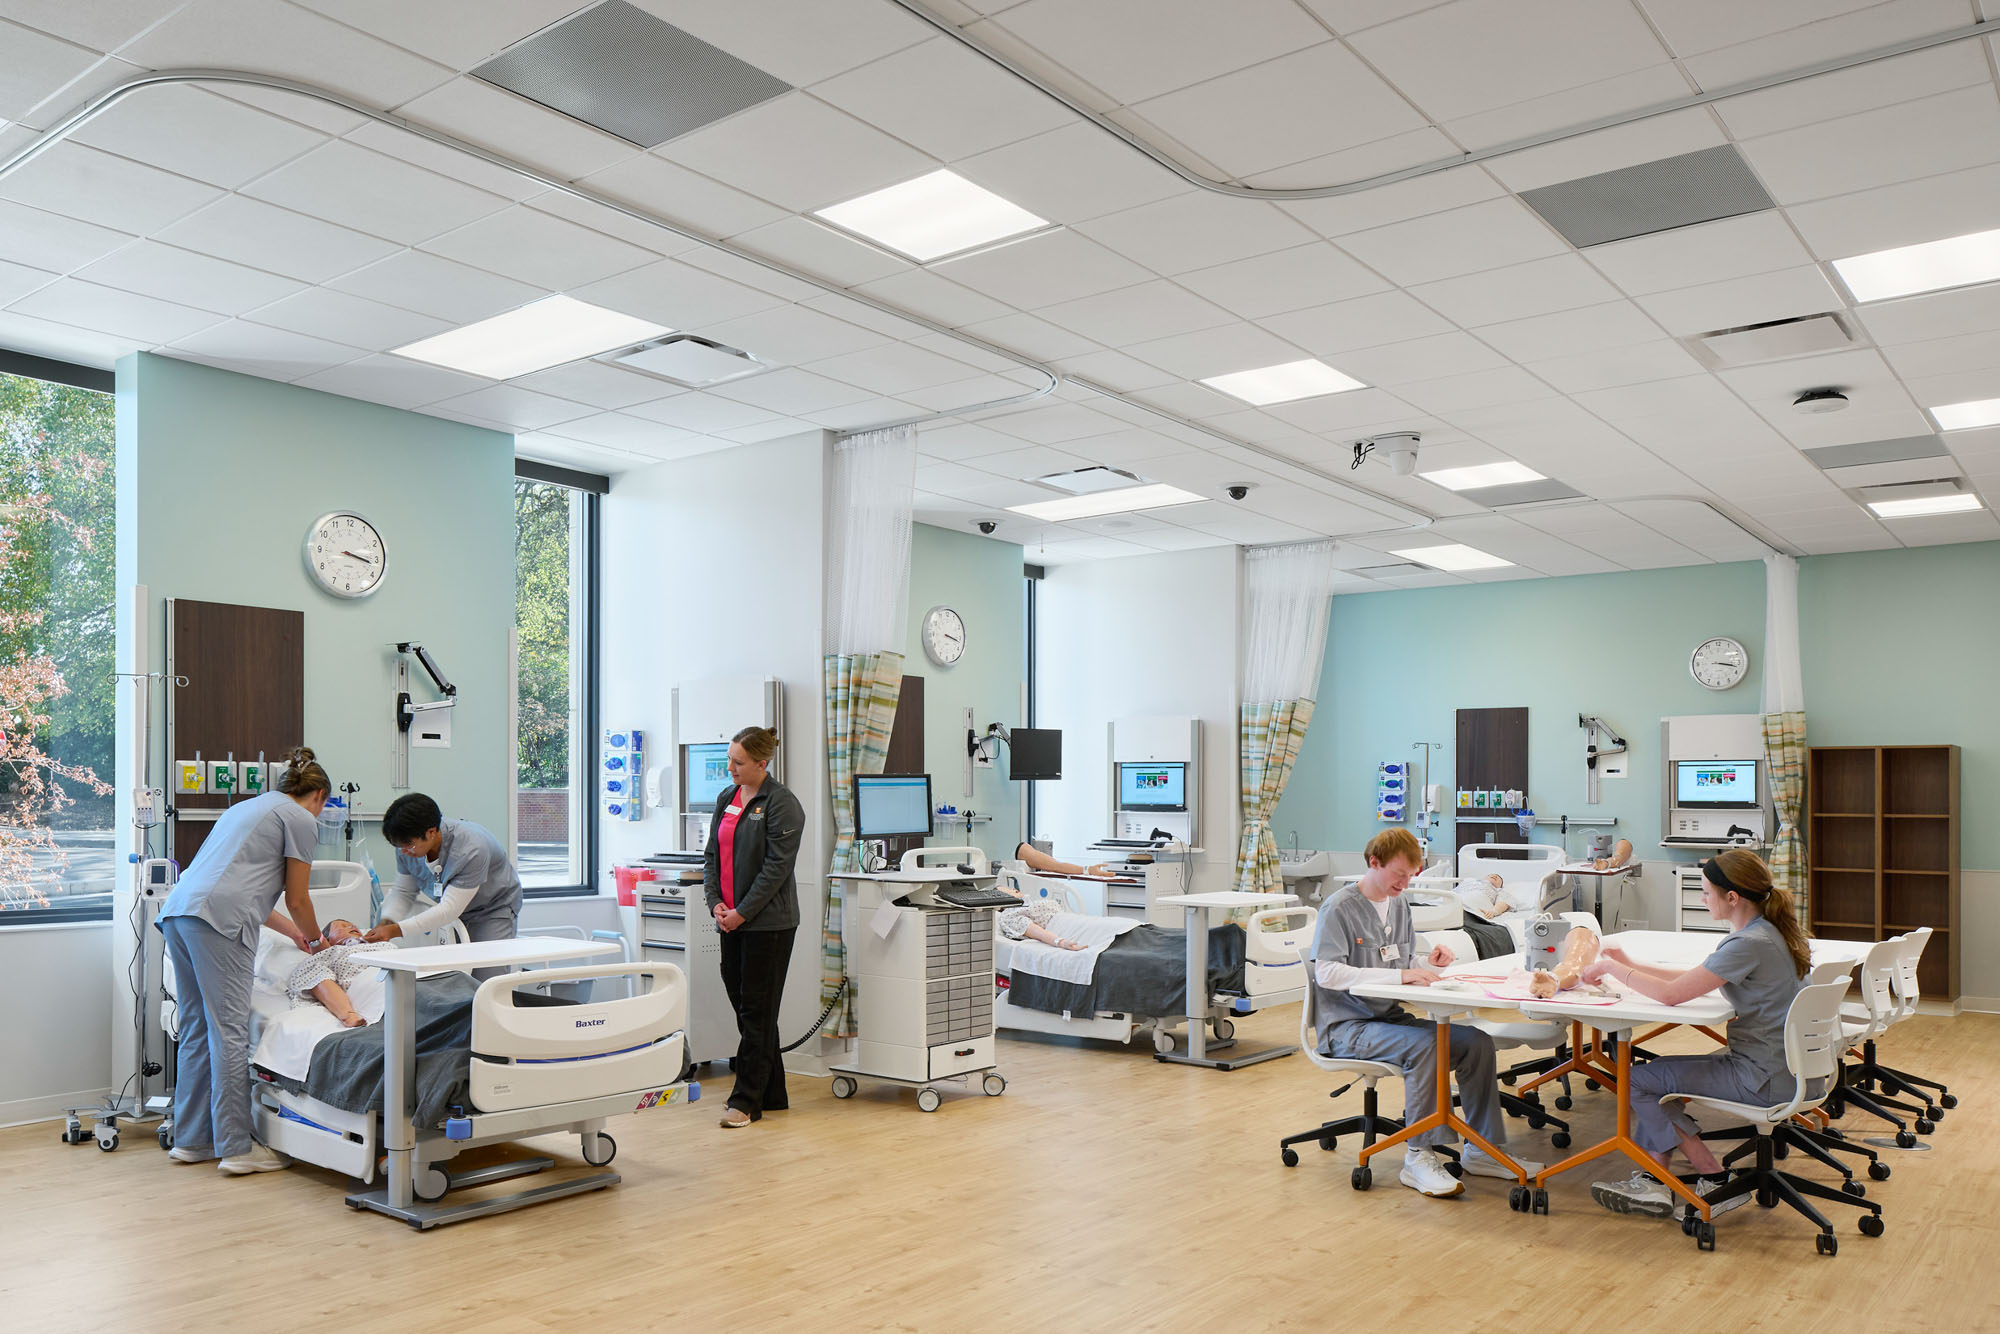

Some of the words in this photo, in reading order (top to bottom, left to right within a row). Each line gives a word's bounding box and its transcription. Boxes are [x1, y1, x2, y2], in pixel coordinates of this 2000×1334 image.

[346, 519, 354, 527] 12
[320, 530, 328, 538] 10
[576, 1020, 606, 1028] Baxter
